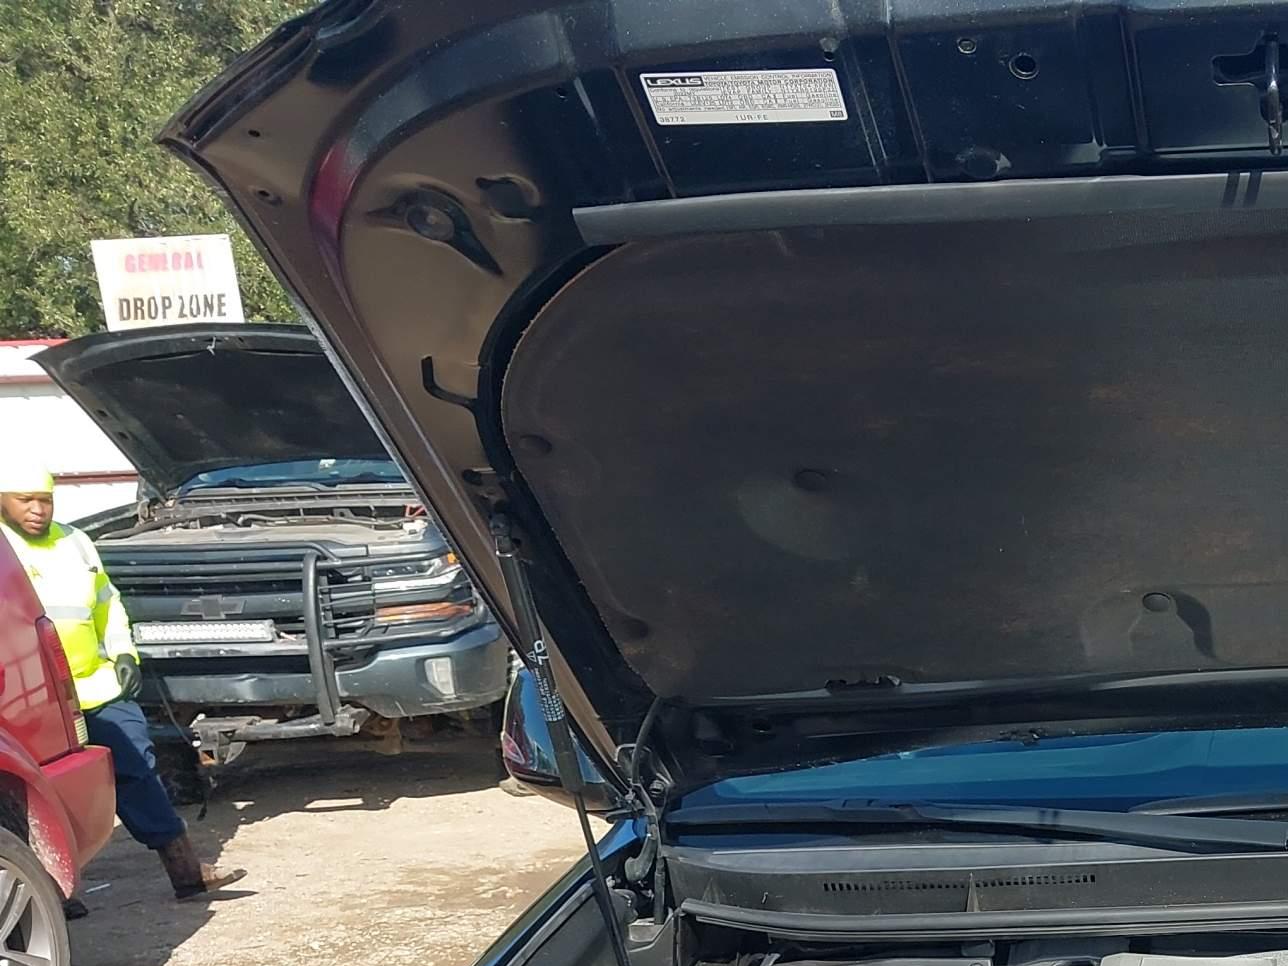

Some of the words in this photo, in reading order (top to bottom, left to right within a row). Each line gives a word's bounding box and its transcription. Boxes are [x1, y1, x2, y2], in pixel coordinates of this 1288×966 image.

[646, 77, 702, 87] LEXUS
[118, 295, 172, 321] DROP
[177, 293, 227, 319] ZONE
